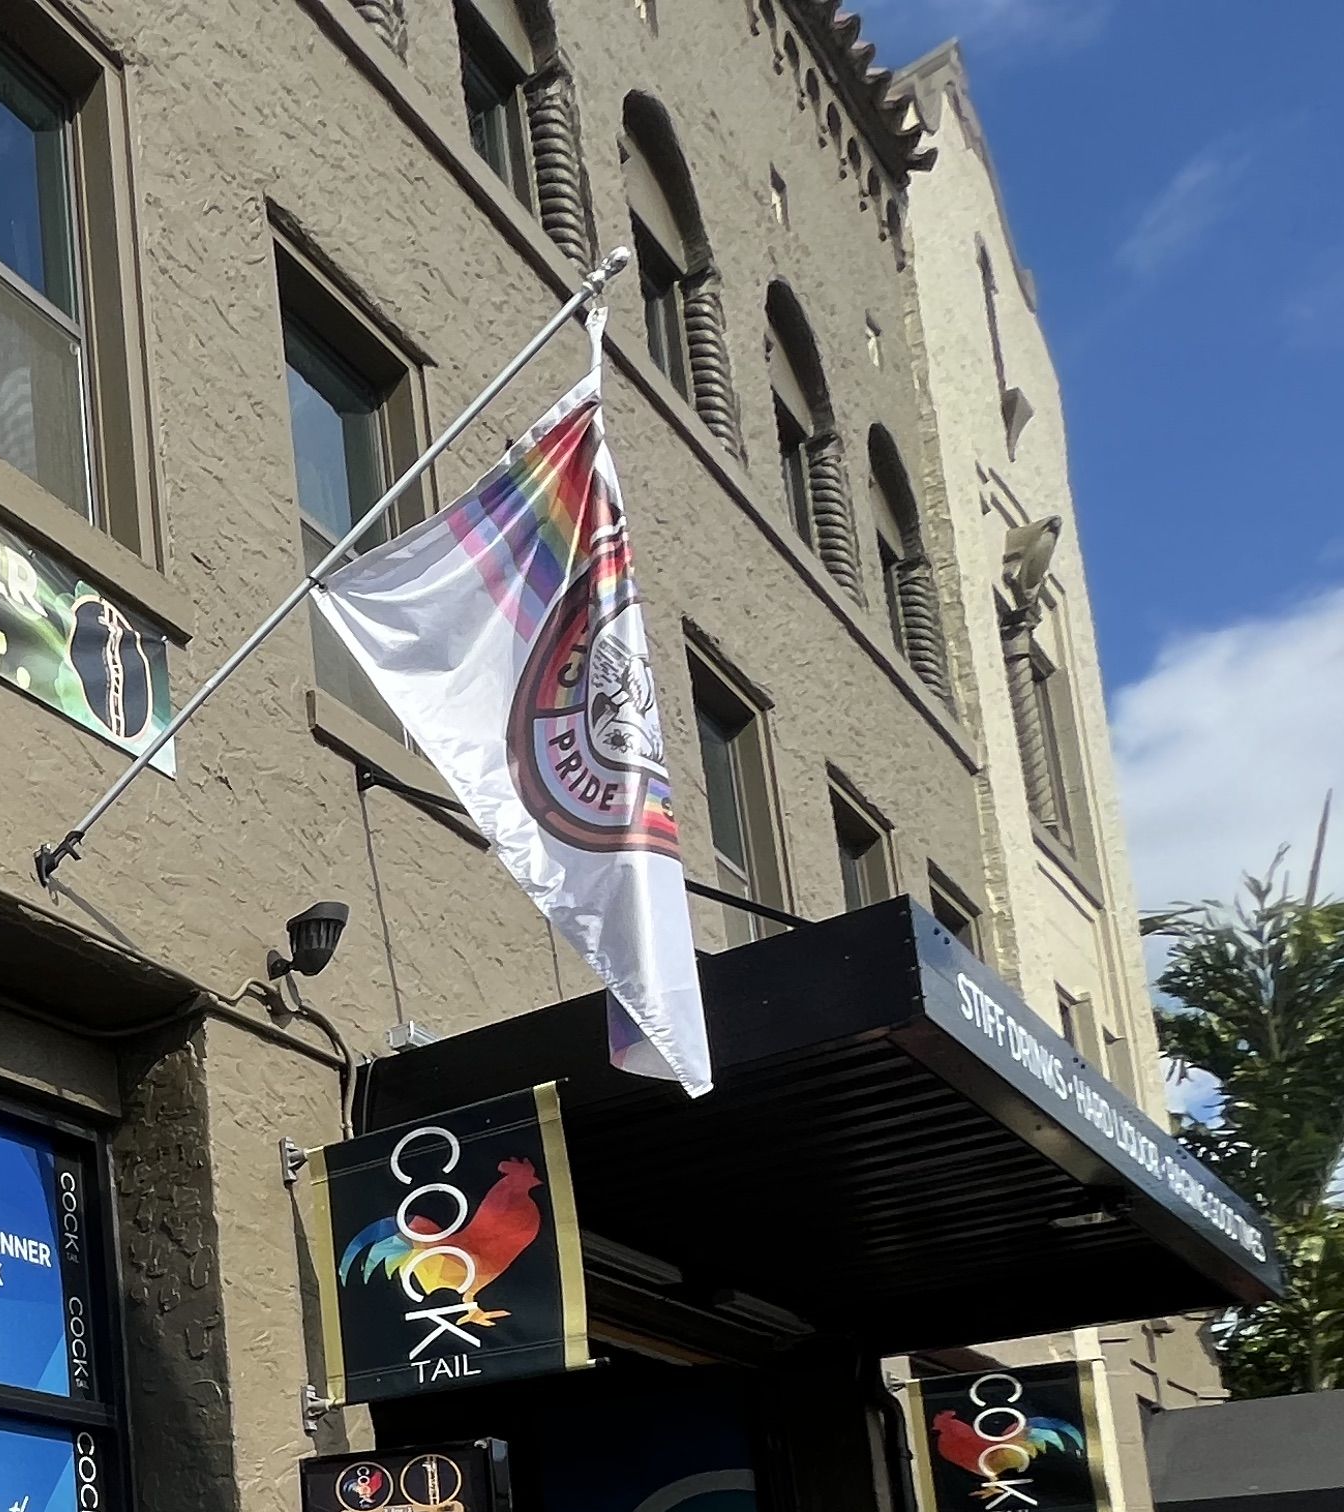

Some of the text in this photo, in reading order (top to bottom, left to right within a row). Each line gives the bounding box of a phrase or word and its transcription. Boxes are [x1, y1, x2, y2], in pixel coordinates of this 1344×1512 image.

[549, 729, 618, 811] PRIDE
[956, 972, 1005, 1047] STIFF
[60, 1171, 80, 1253] COCK
[390, 1126, 482, 1360] COCK
[68, 1296, 89, 1379] COCK
[411, 1354, 482, 1384] TAIL
[969, 1373, 1038, 1510] COCK
